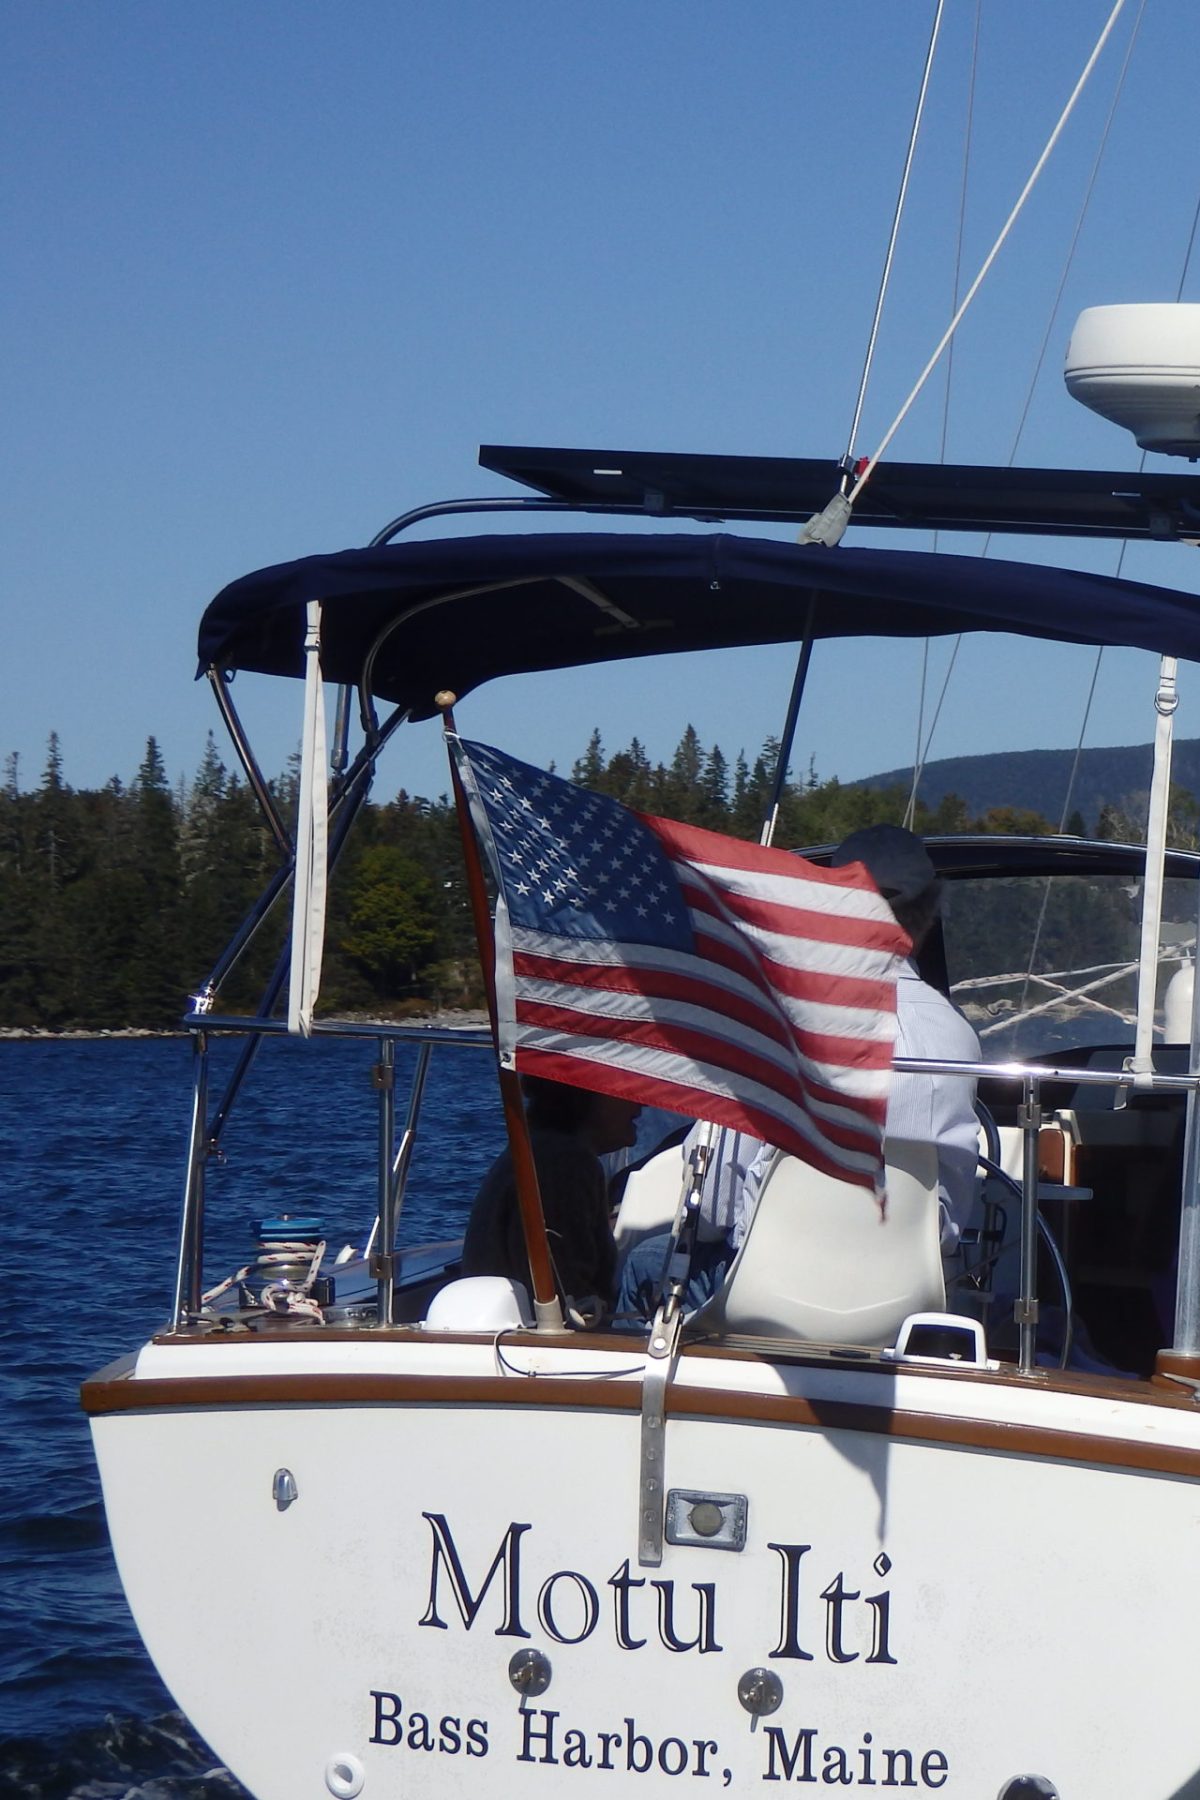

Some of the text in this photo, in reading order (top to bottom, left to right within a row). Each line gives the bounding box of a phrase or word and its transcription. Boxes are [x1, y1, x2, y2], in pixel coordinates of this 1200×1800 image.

[418, 1511, 899, 1665] Motu Iti
[368, 1690, 950, 1789] Bass Harbor, Maine
